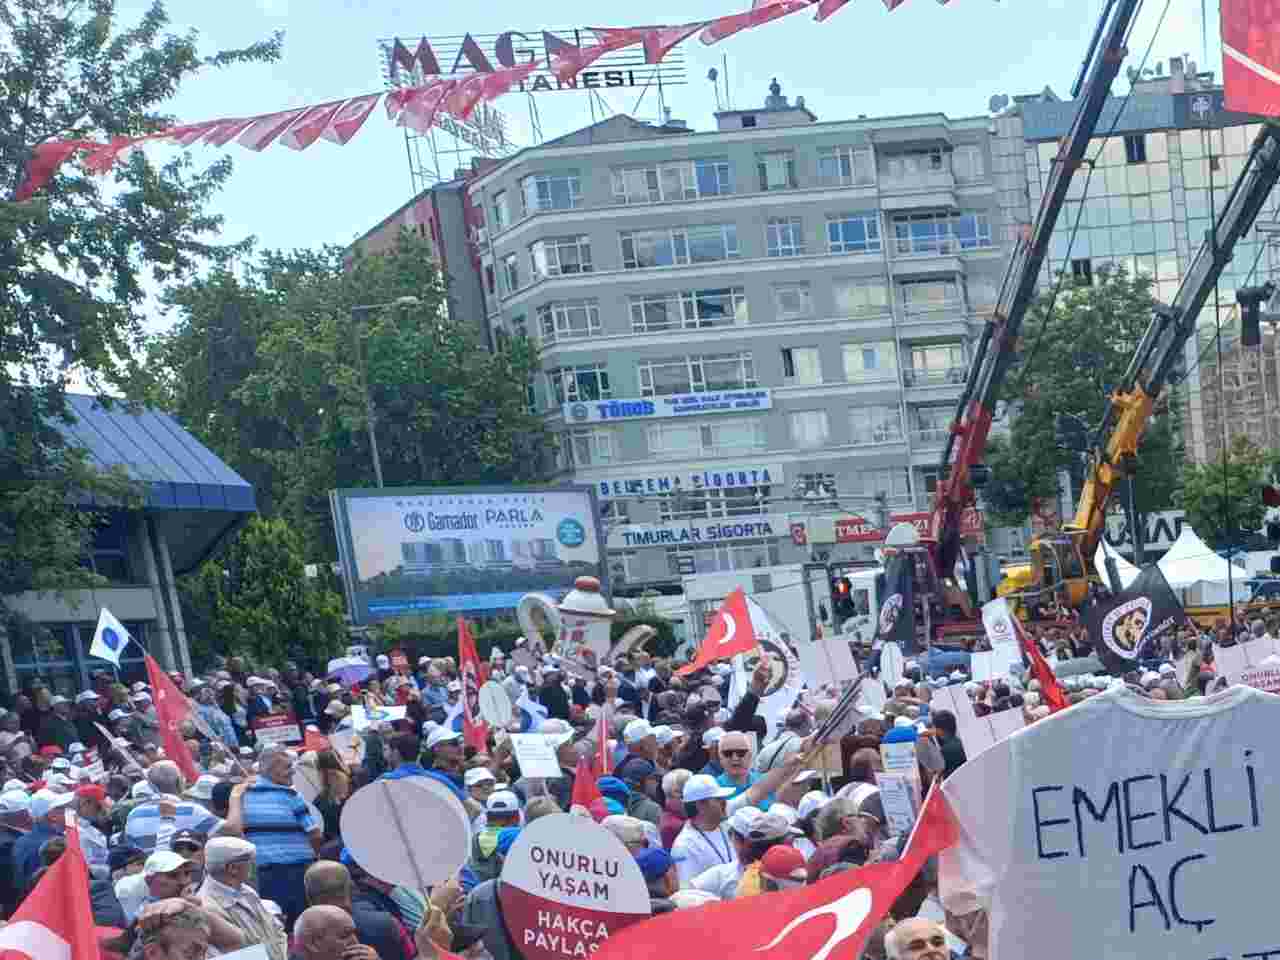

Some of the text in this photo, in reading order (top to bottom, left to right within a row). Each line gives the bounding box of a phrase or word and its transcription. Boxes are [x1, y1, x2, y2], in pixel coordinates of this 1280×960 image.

[485, 508, 544, 524] PARLA
[705, 522, 773, 541] SİGORTA
[1032, 749, 1260, 859] EMEKLİ
[530, 846, 619, 878] ONURLU
[538, 871, 610, 900] YAŞAM
[1128, 853, 1217, 934] AÇ
[537, 911, 610, 939] HAKÇA
